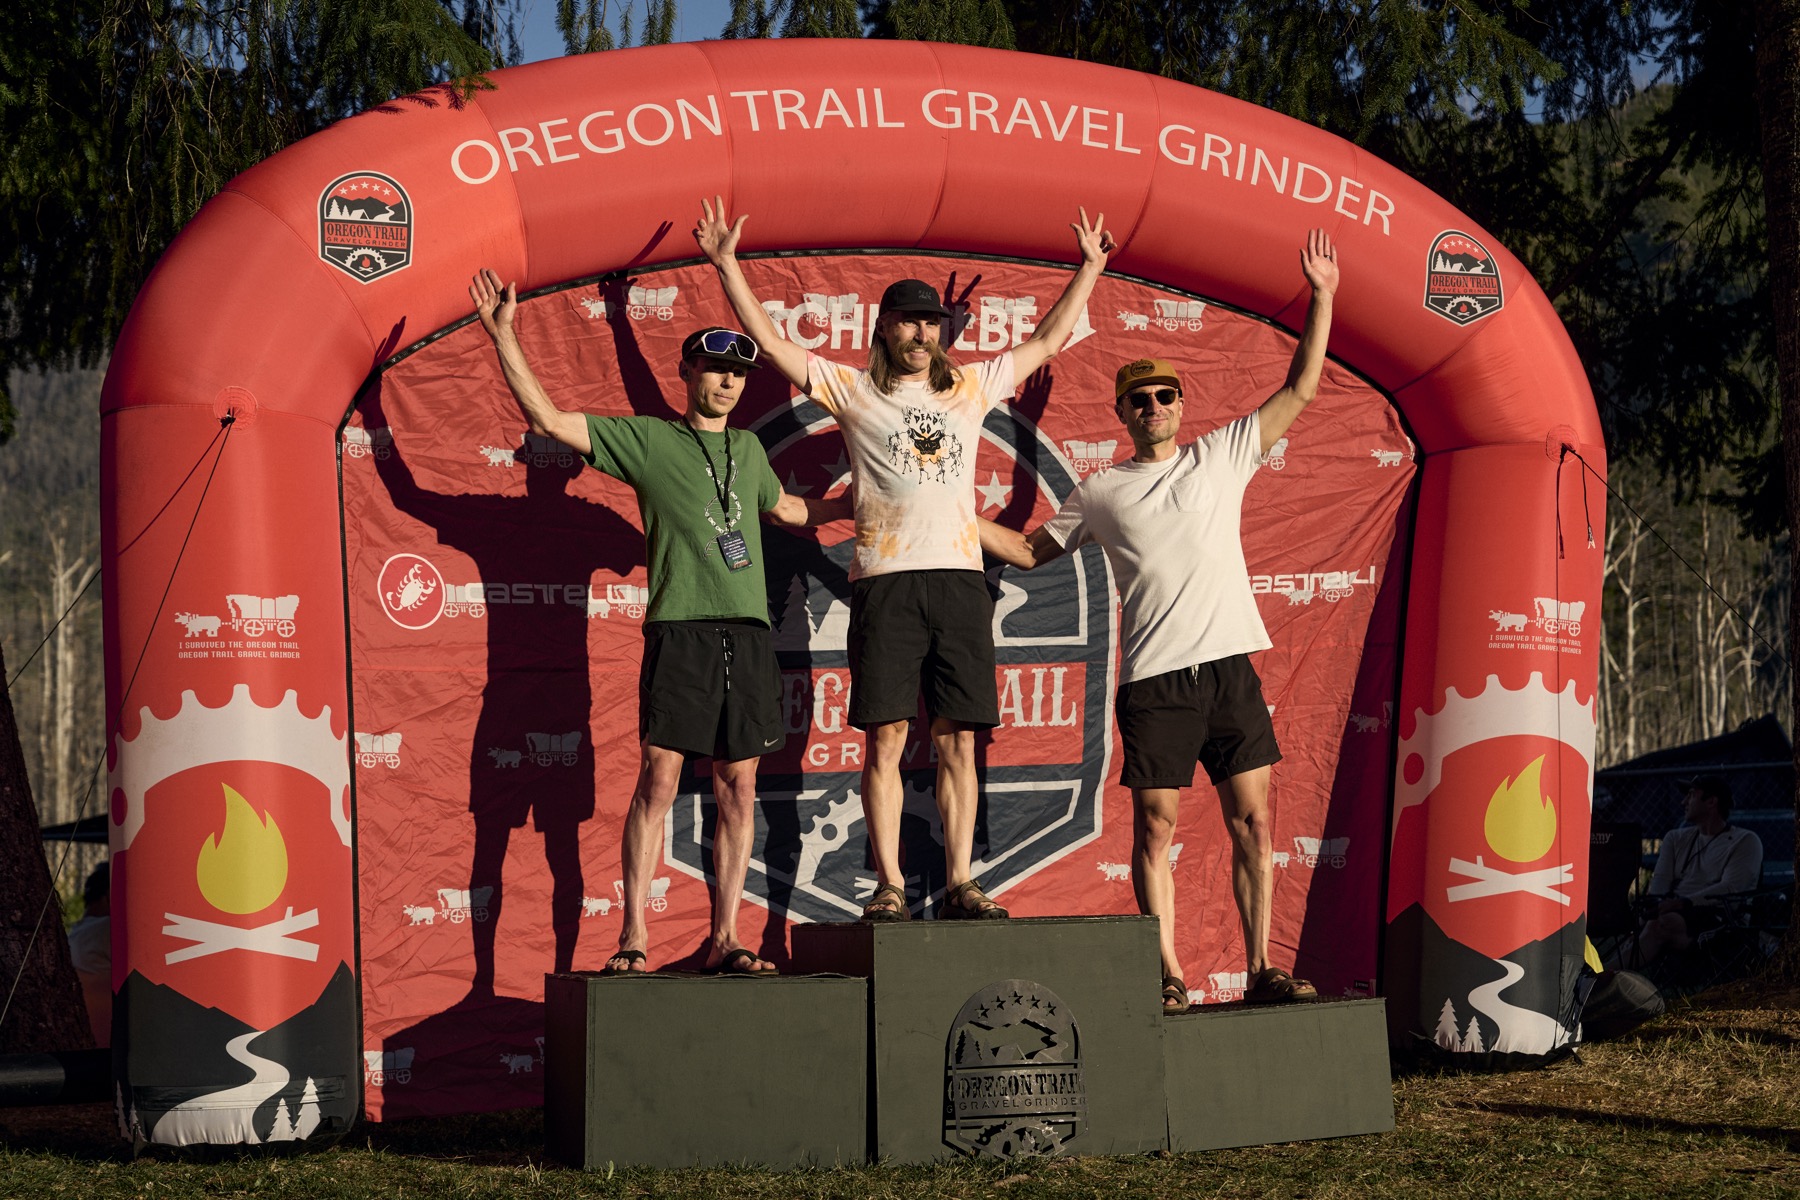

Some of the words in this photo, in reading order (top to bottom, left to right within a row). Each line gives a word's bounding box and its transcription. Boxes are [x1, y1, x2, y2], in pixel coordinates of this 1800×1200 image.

[450, 94, 724, 185] OREGON
[730, 88, 905, 132] TRAIL
[921, 88, 1142, 154] GRAVEL
[1158, 124, 1396, 237] GRINDER
[327, 223, 371, 238] OREGON
[374, 227, 406, 240] TRAIL
[1432, 275, 1469, 288] OREGON
[1470, 276, 1497, 289] TRAIL
[179, 641, 183, 649] I
[185, 641, 226, 649] SURVIVED
[228, 641, 244, 649] THE
[246, 641, 277, 649] OREGON
[279, 641, 300, 650] TRAIL
[1495, 634, 1530, 642] SURVIVED
[1531, 635, 1543, 643] THE
[1568, 639, 1582, 647] TRAIL
[178, 651, 209, 659] OREGON
[211, 650, 235, 658] TRAIL
[237, 650, 268, 658] GRAVEL
[269, 651, 301, 659] GRINDER
[998, 666, 1077, 728] AIL
[958, 1074, 1034, 1099] OREGON
[959, 1100, 1020, 1110] GRAVEL
[1024, 1097, 1086, 1107] GRINDER
